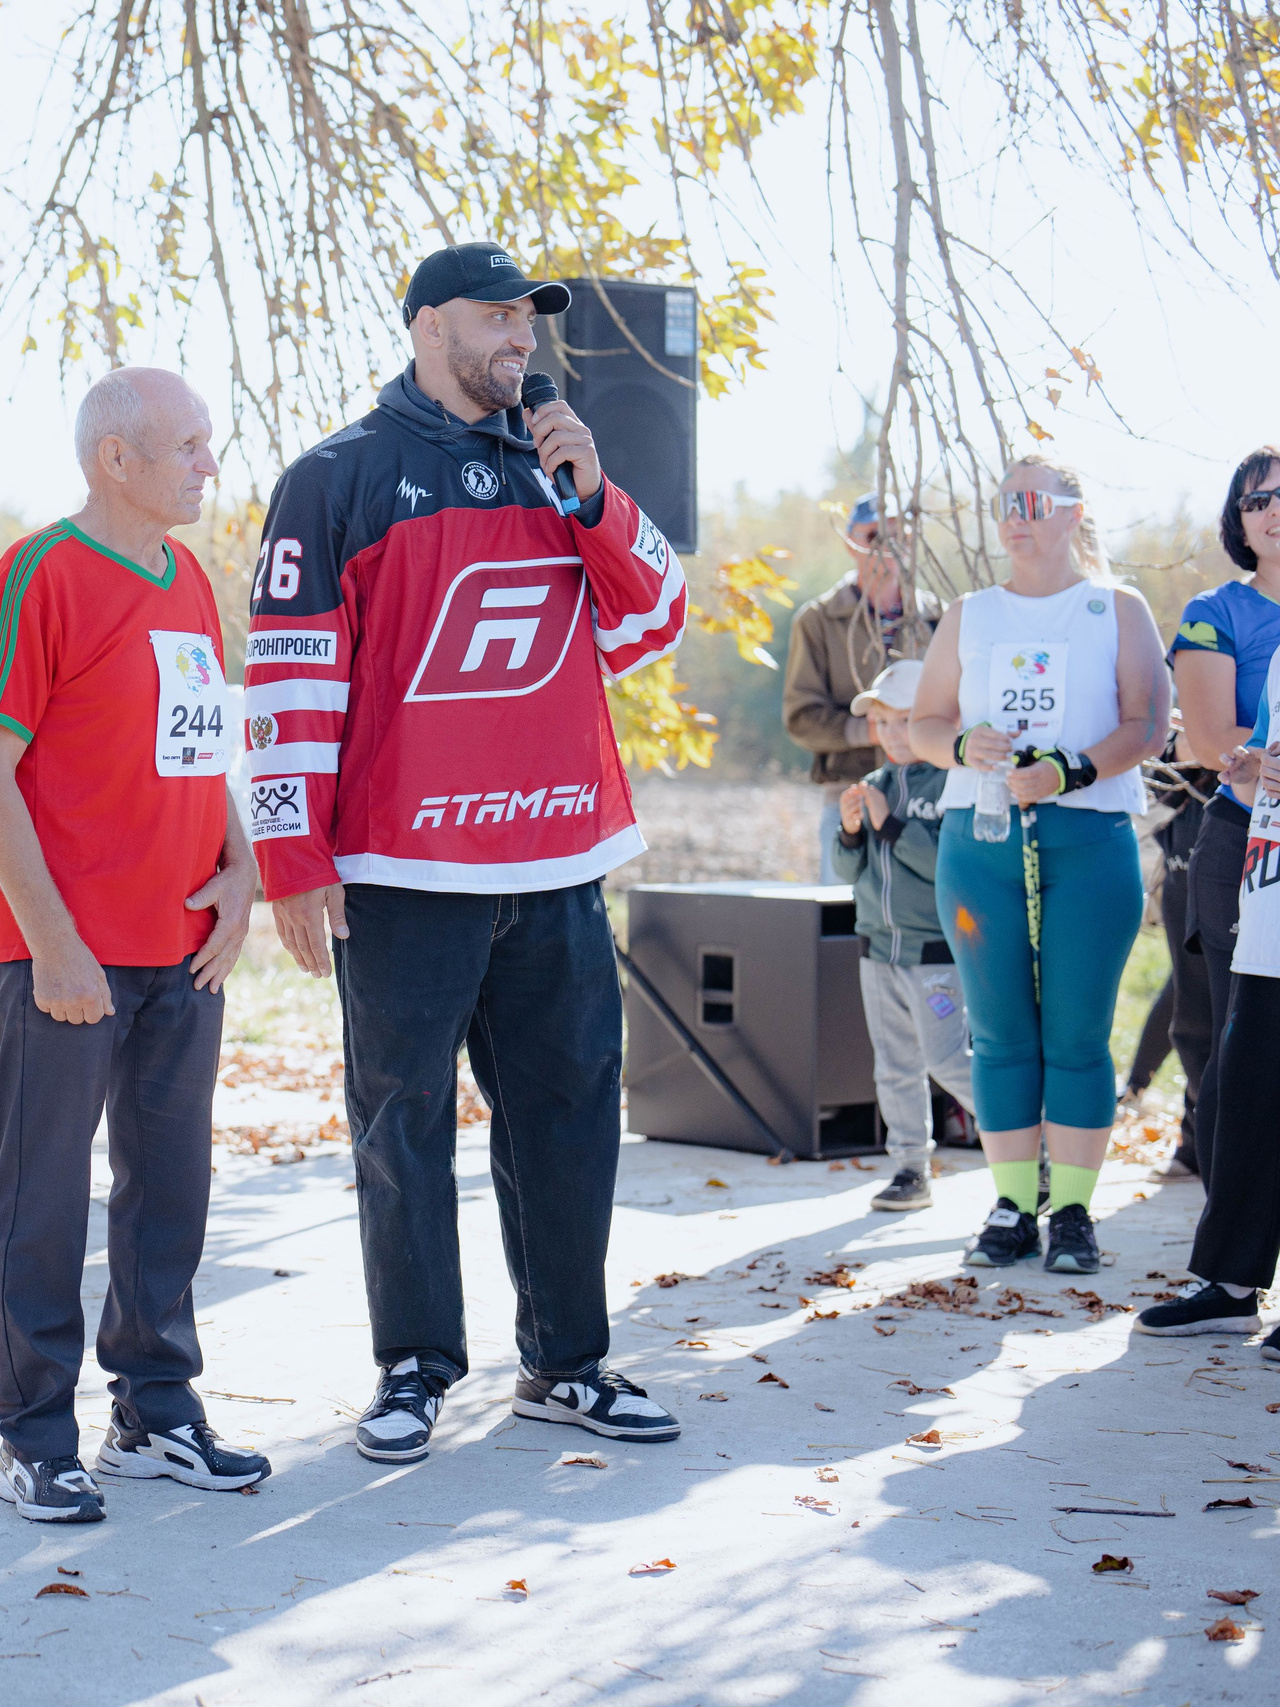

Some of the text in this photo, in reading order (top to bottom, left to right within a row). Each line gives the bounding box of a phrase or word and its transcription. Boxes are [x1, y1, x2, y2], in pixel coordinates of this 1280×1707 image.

[1002, 688, 1056, 711] 255
[169, 704, 224, 738] 244
[412, 782, 599, 830] АТАМАН
[266, 822, 302, 833] РОССИИ
